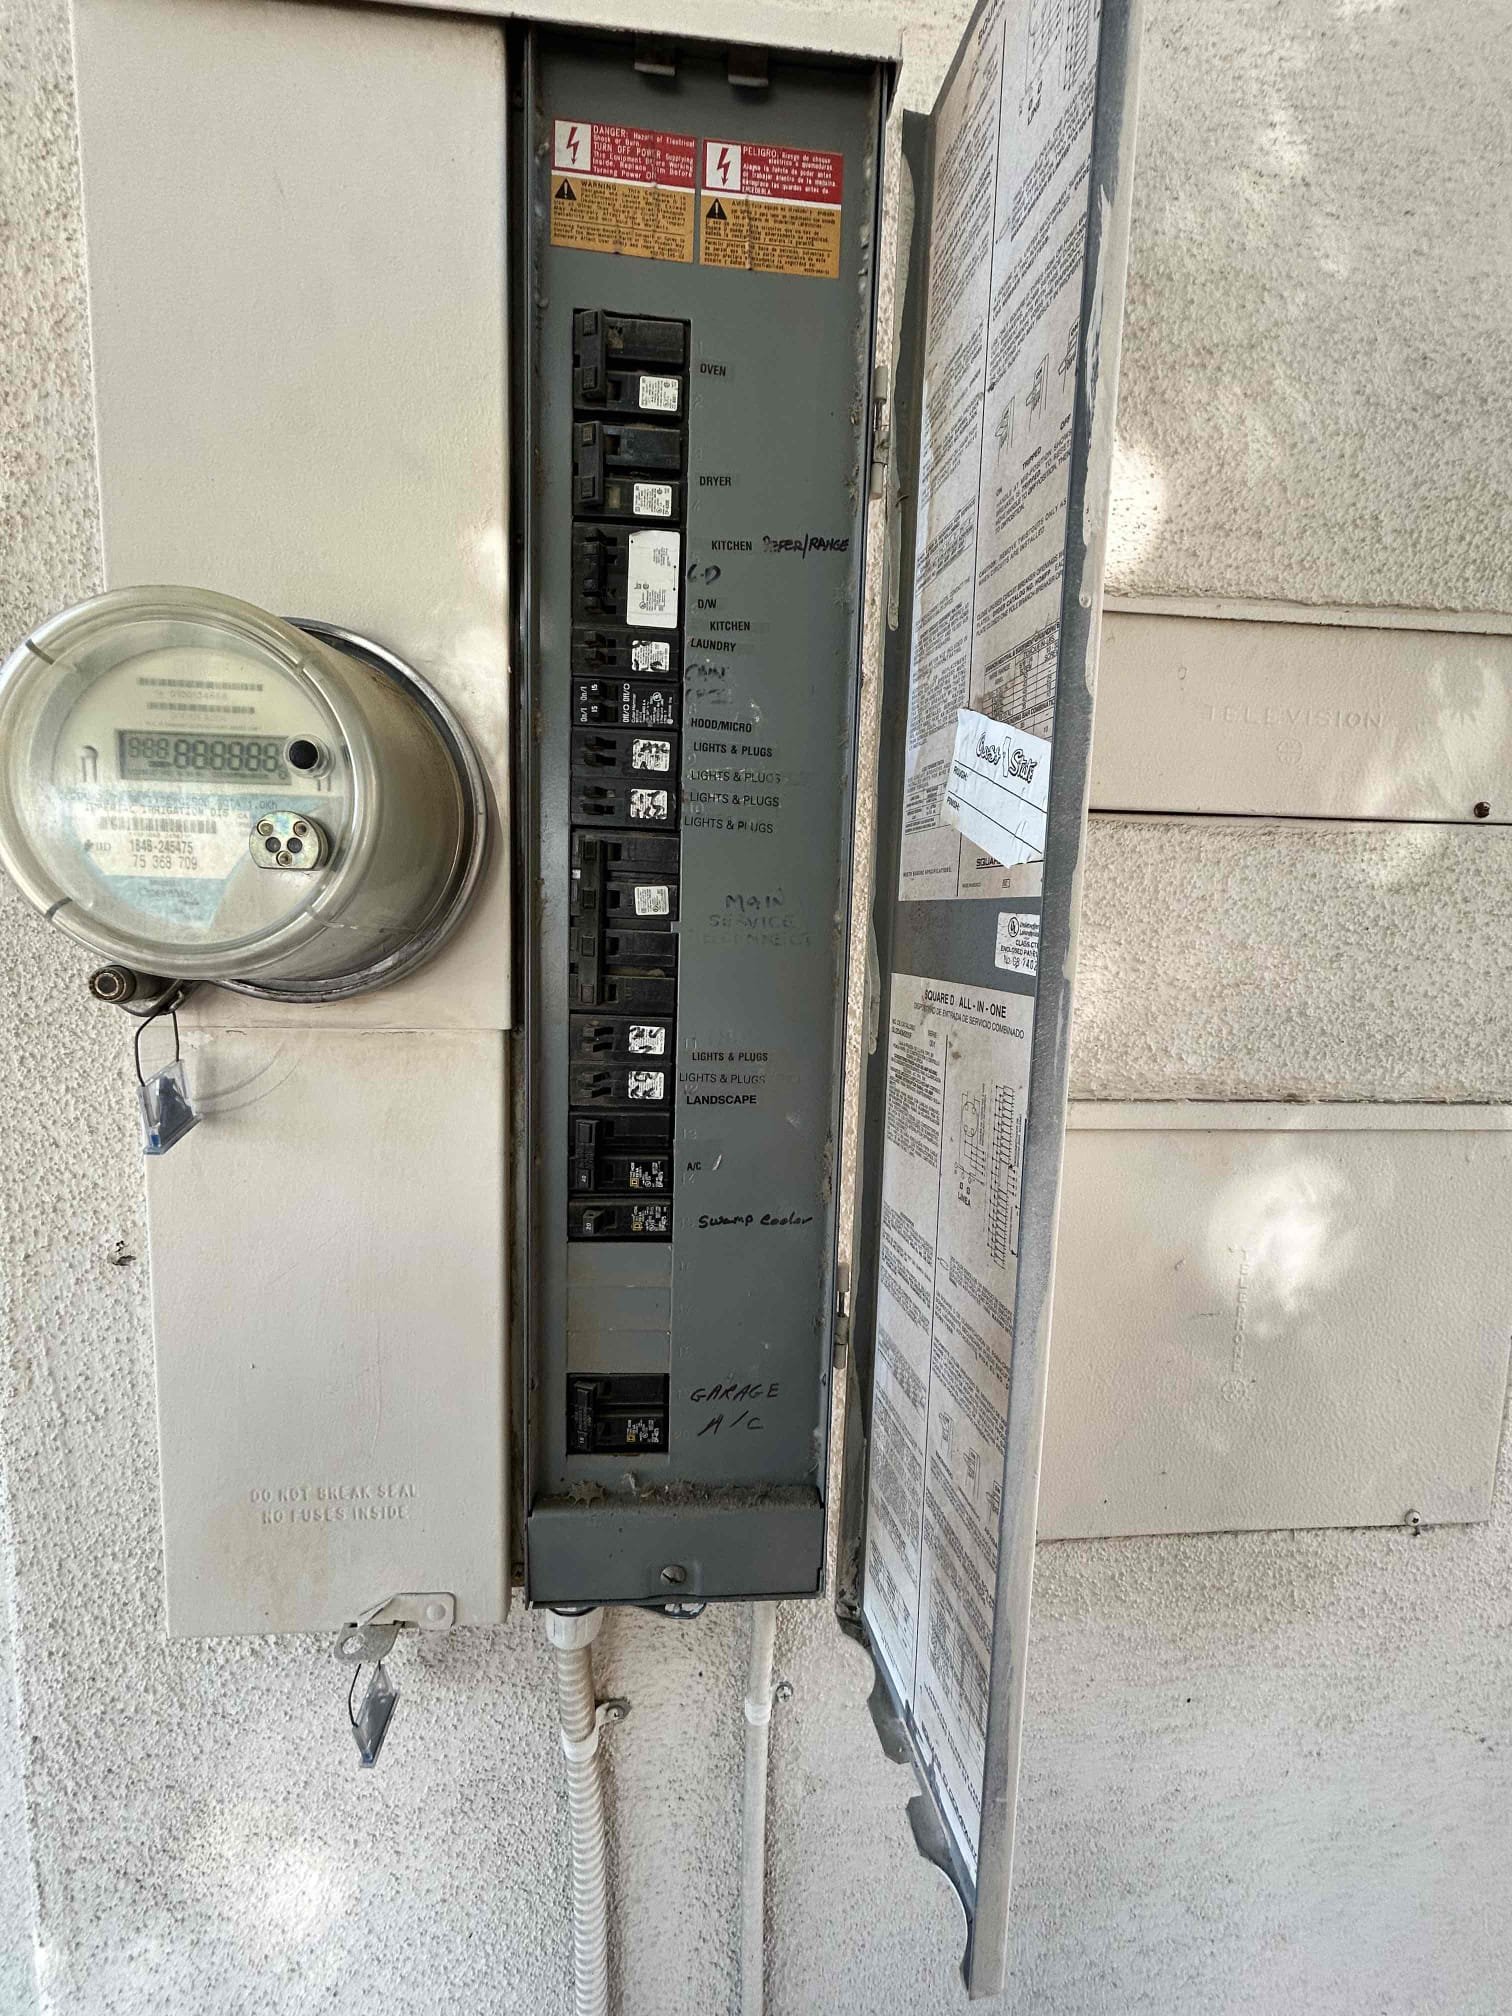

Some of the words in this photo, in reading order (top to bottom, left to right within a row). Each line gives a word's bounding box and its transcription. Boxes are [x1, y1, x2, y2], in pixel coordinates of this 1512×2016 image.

[593, 125, 629, 137] DANGER:
[594, 142, 612, 152] TURN
[618, 146, 630, 154] OFF
[637, 148, 660, 158] POWR
[622, 170, 641, 178] Power
[700, 364, 726, 376] OVEN
[700, 476, 731, 487] DRYER
[1044, 503, 1057, 522] ONLY
[711, 540, 752, 551] KITCHEN
[698, 599, 717, 609] D/W
[710, 621, 750, 631] KITCHEN
[691, 638, 736, 652] LAUNDRY
[1200, 704, 1385, 728] TELEVISION
[691, 718, 752, 733] HOOD/MICRO
[694, 742, 726, 754] LIGHTS
[731, 745, 737, 754] &
[742, 746, 772, 757] PLUGS
[691, 770, 730, 781] LIGHTS
[733, 772, 740, 781] &
[690, 792, 729, 803] LIGHTS
[732, 795, 740, 805] &
[743, 795, 779, 807] PLUGS
[684, 816, 723, 829] LIGHTS
[726, 820, 734, 830] &
[976, 858, 1001, 866] SQUA
[925, 989, 948, 1004] SQUARE
[950, 994, 954, 1005] D
[943, 1009, 961, 1022] ENTRADA
[962, 1014, 968, 1024] DE
[969, 1016, 991, 1030] SERVICIO
[992, 1022, 1024, 1039] COMBINADO
[692, 1052, 724, 1061] LIGHTS
[728, 1053, 734, 1061] &
[738, 1053, 768, 1061] PLUGS
[680, 1073, 716, 1083] LIGHTS
[720, 1074, 727, 1083] &
[731, 1074, 765, 1084] PLUGS
[686, 1095, 757, 1104] LANDSCAPE
[687, 1162, 701, 1171] A/C
[698, 1214, 754, 1228] Swamp
[690, 1384, 780, 1402] GARAGE
[697, 1410, 765, 1437] A/C
[250, 1489, 270, 1502] DO
[279, 1488, 308, 1502] NOT
[318, 1485, 371, 1500] BREAK
[378, 1484, 418, 1499] SEAL
[262, 1511, 284, 1524] NO
[291, 1508, 345, 1523] FUSES
[352, 1506, 408, 1520] INSIDE
